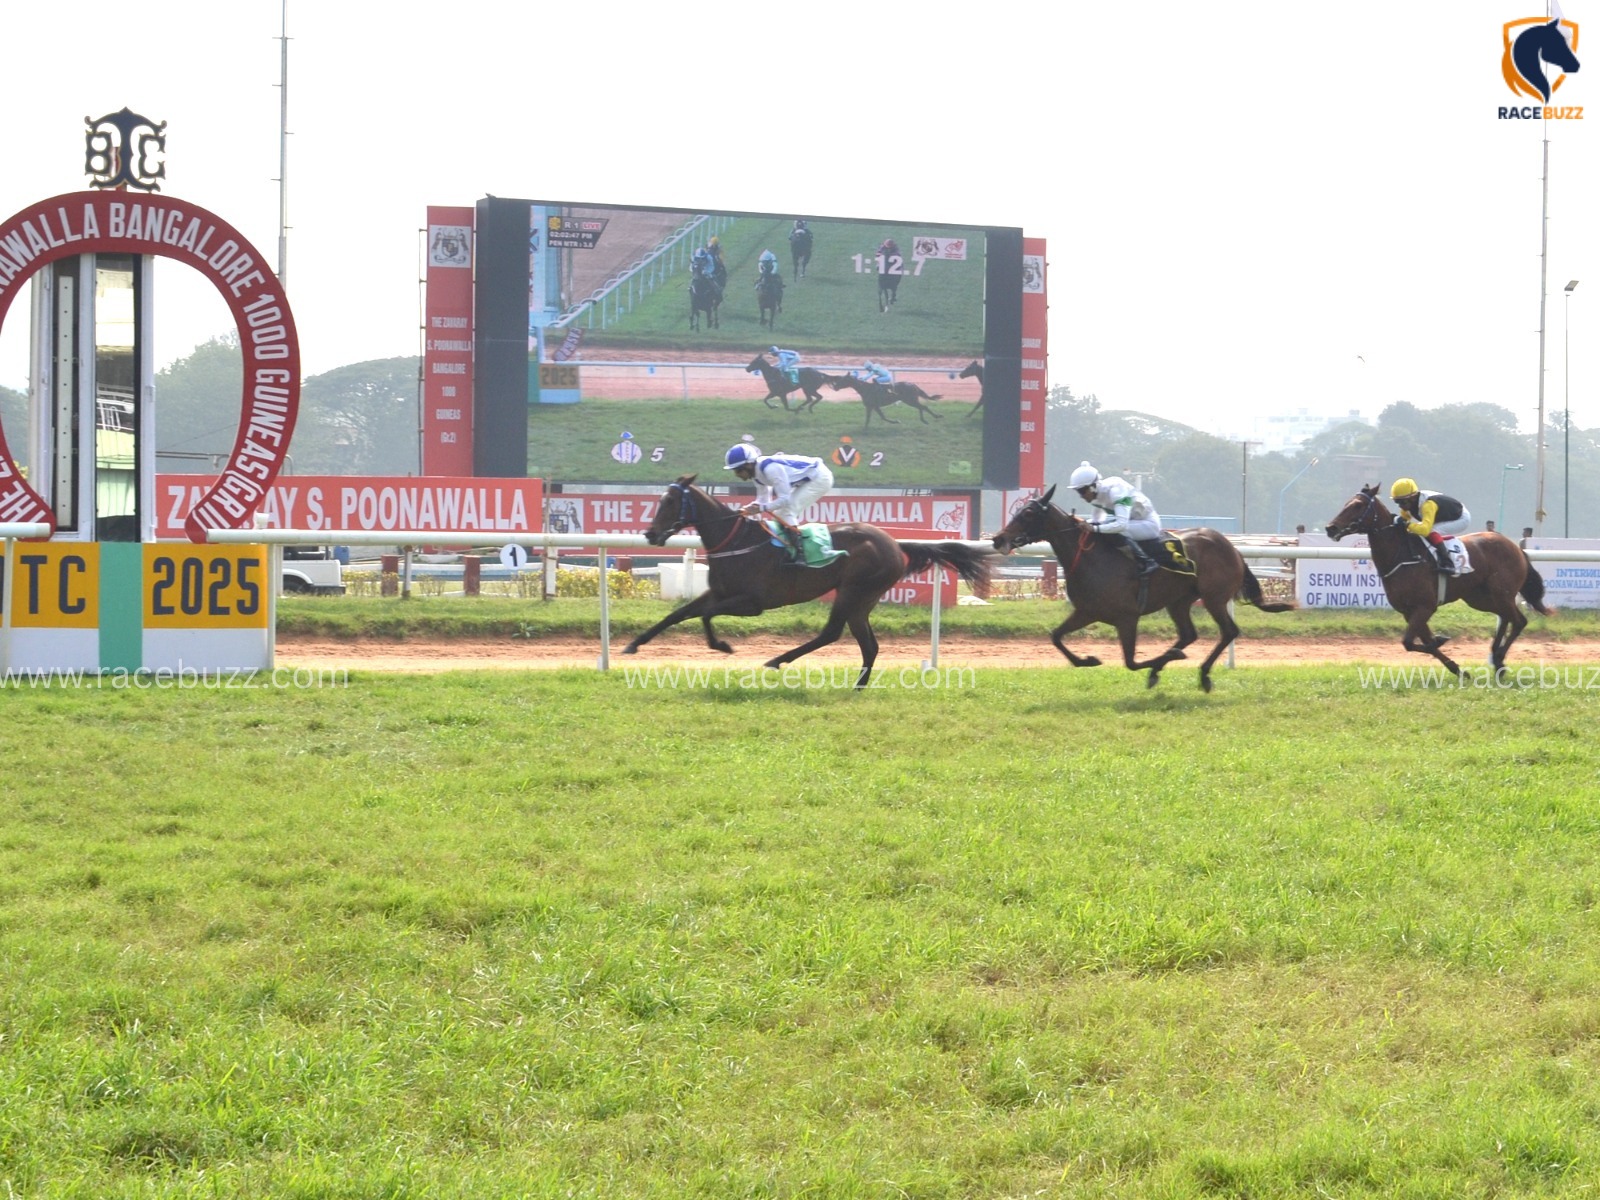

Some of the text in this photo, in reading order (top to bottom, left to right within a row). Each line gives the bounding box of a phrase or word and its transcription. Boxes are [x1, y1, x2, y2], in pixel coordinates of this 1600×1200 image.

[851, 253, 927, 277] 1:12.7
[0, 203, 100, 294] AWALLA
[109, 203, 265, 298] BANGALORE
[243, 294, 289, 360] 1000
[541, 367, 578, 387] 2025
[650, 447, 665, 463] 5
[869, 451, 884, 467] 2
[306, 486, 332, 531] S.
[341, 486, 528, 531] POONAWALLA
[591, 500, 633, 523] THE
[509, 546, 518, 567] 1
[0, 554, 86, 615] TC
[152, 556, 260, 616] 2025
[1309, 573, 1352, 587] SERUM
[1306, 592, 1388, 607] OF INDIA PVT.
